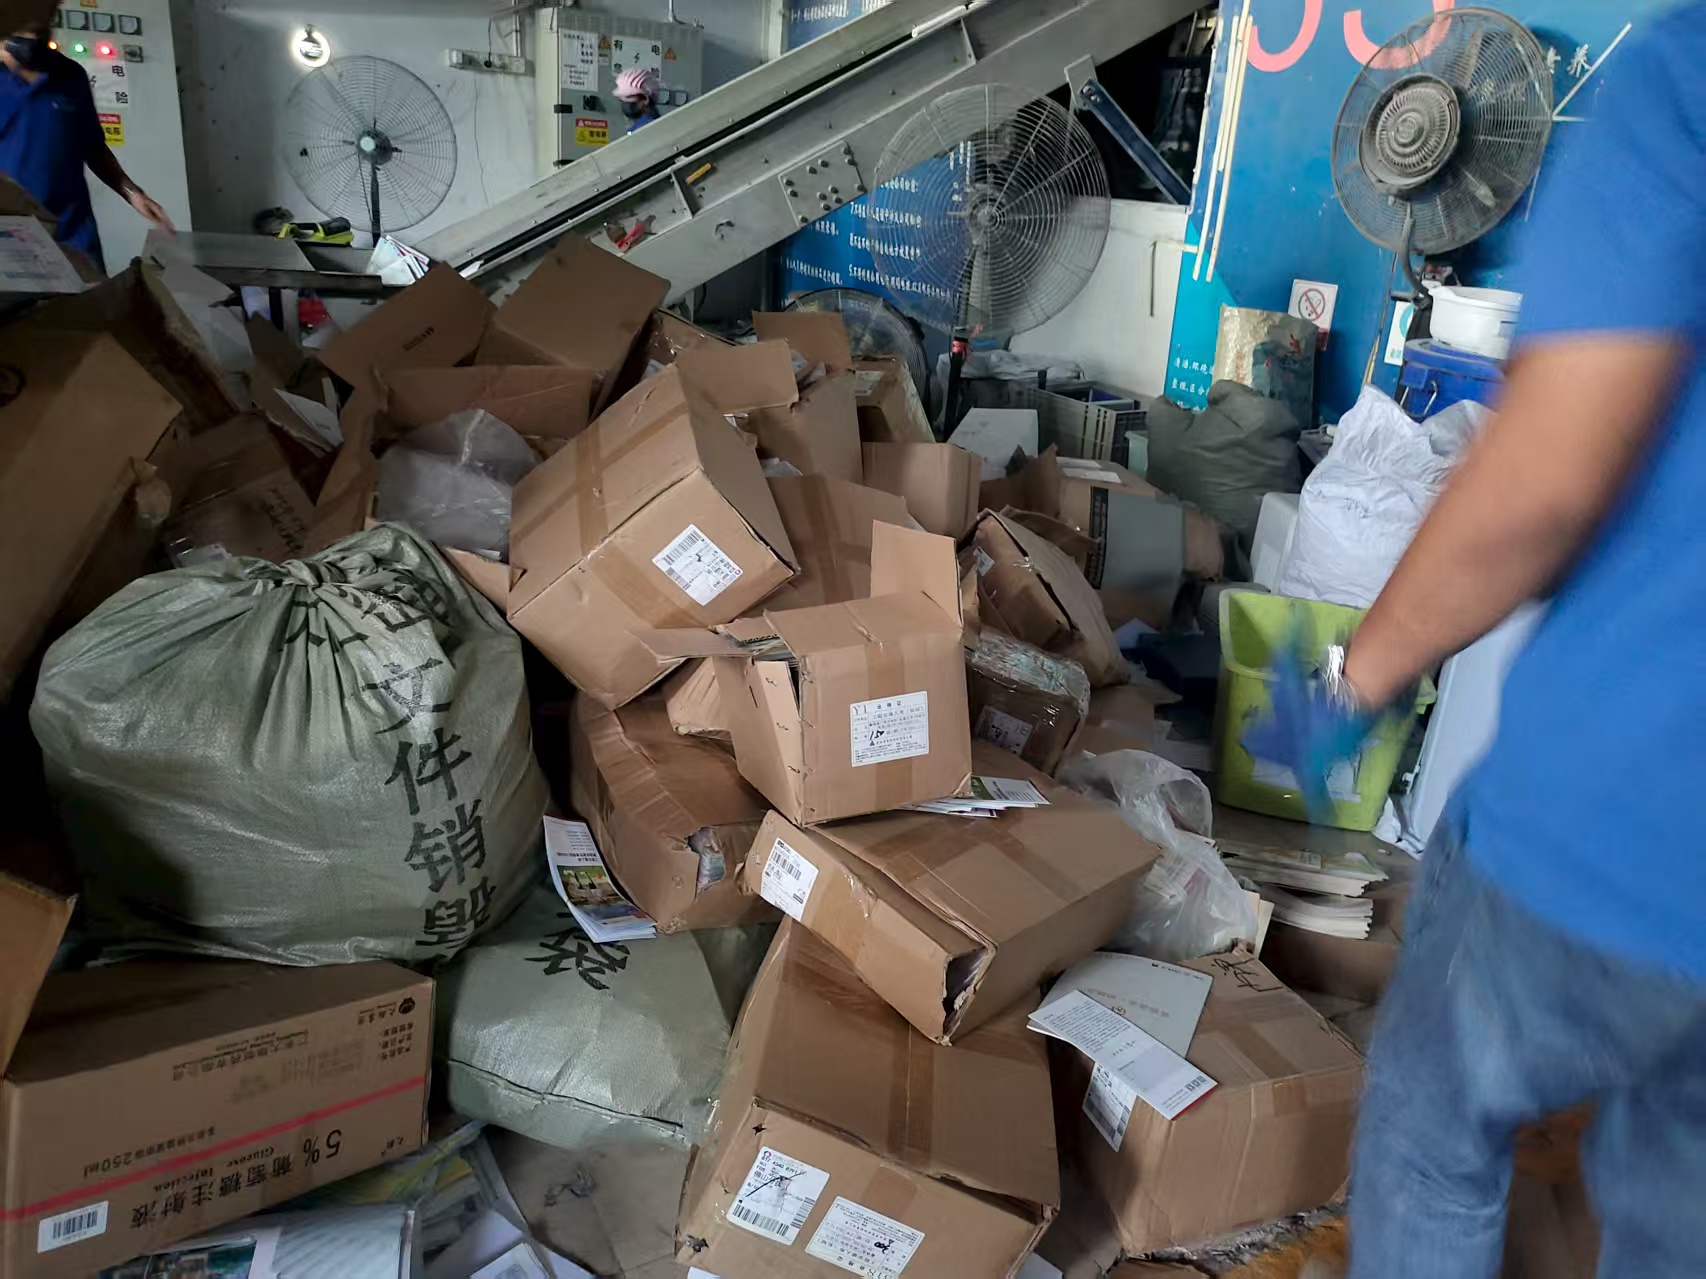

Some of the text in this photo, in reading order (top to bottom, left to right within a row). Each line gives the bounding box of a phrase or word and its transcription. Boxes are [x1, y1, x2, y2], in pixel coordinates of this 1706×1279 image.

[130, 1129, 342, 1230] 5% 葡萄糖注射液
